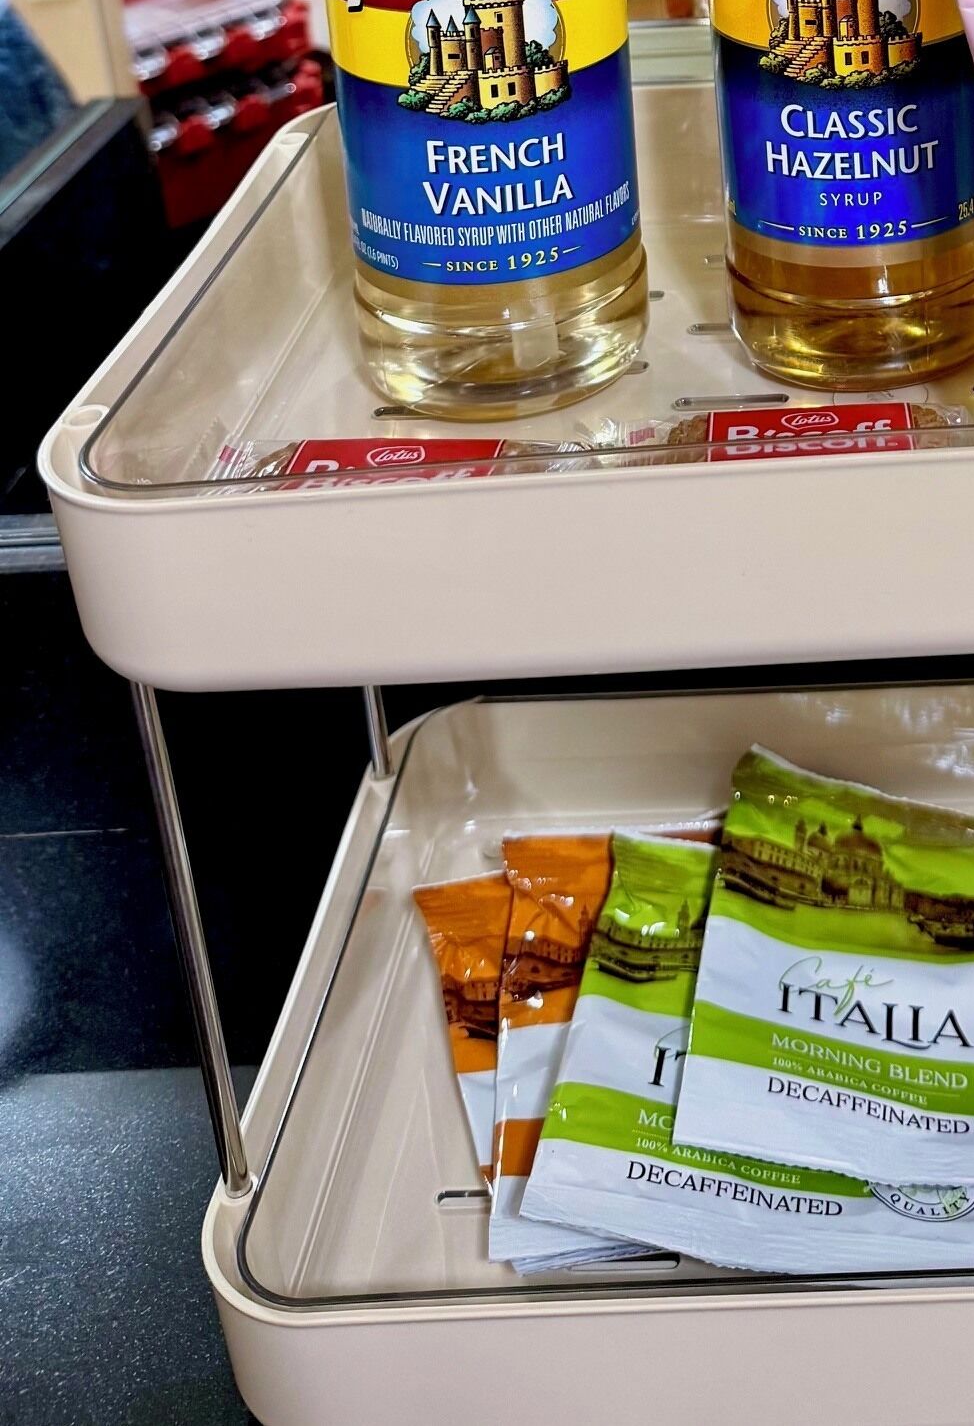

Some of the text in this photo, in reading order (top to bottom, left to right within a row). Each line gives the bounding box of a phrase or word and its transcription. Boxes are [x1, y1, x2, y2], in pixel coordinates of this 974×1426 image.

[780, 104, 918, 139] CLASSIC
[426, 132, 566, 174] FRENCH
[765, 139, 939, 180] HAZELNUT
[361, 207, 402, 241] NATURALLY
[403, 222, 455, 247] FLAVORED
[457, 224, 494, 246] SYRUP
[497, 222, 526, 246] WITH
[528, 215, 563, 240] OTHER
[565, 196, 605, 231] NATURAL
[605, 180, 631, 215] FLAVORS
[422, 173, 574, 216] VANILLA
[819, 191, 883, 207] SYRUP
[799, 220, 909, 240] SINCE 1925
[376, 250, 400, 270] PINTS)
[446, 246, 560, 273] SINCE 1925
[726, 418, 893, 456] Biscoff
[790, 414, 833, 426] Lotus
[374, 448, 420, 463] Lotus
[778, 955, 895, 1017] Café
[777, 981, 974, 1051] ITALIA
[771, 1032, 969, 1090] MORNING BLEND
[772, 1056, 928, 1106] 100% ARABICA COFFEE
[767, 1075, 971, 1134] DECAFFEINATED
[635, 1136, 801, 1184] 100% ARABICA COFFEE
[626, 1159, 844, 1216] DECAFFEINATED
[890, 1191, 971, 1217] QUALITY
